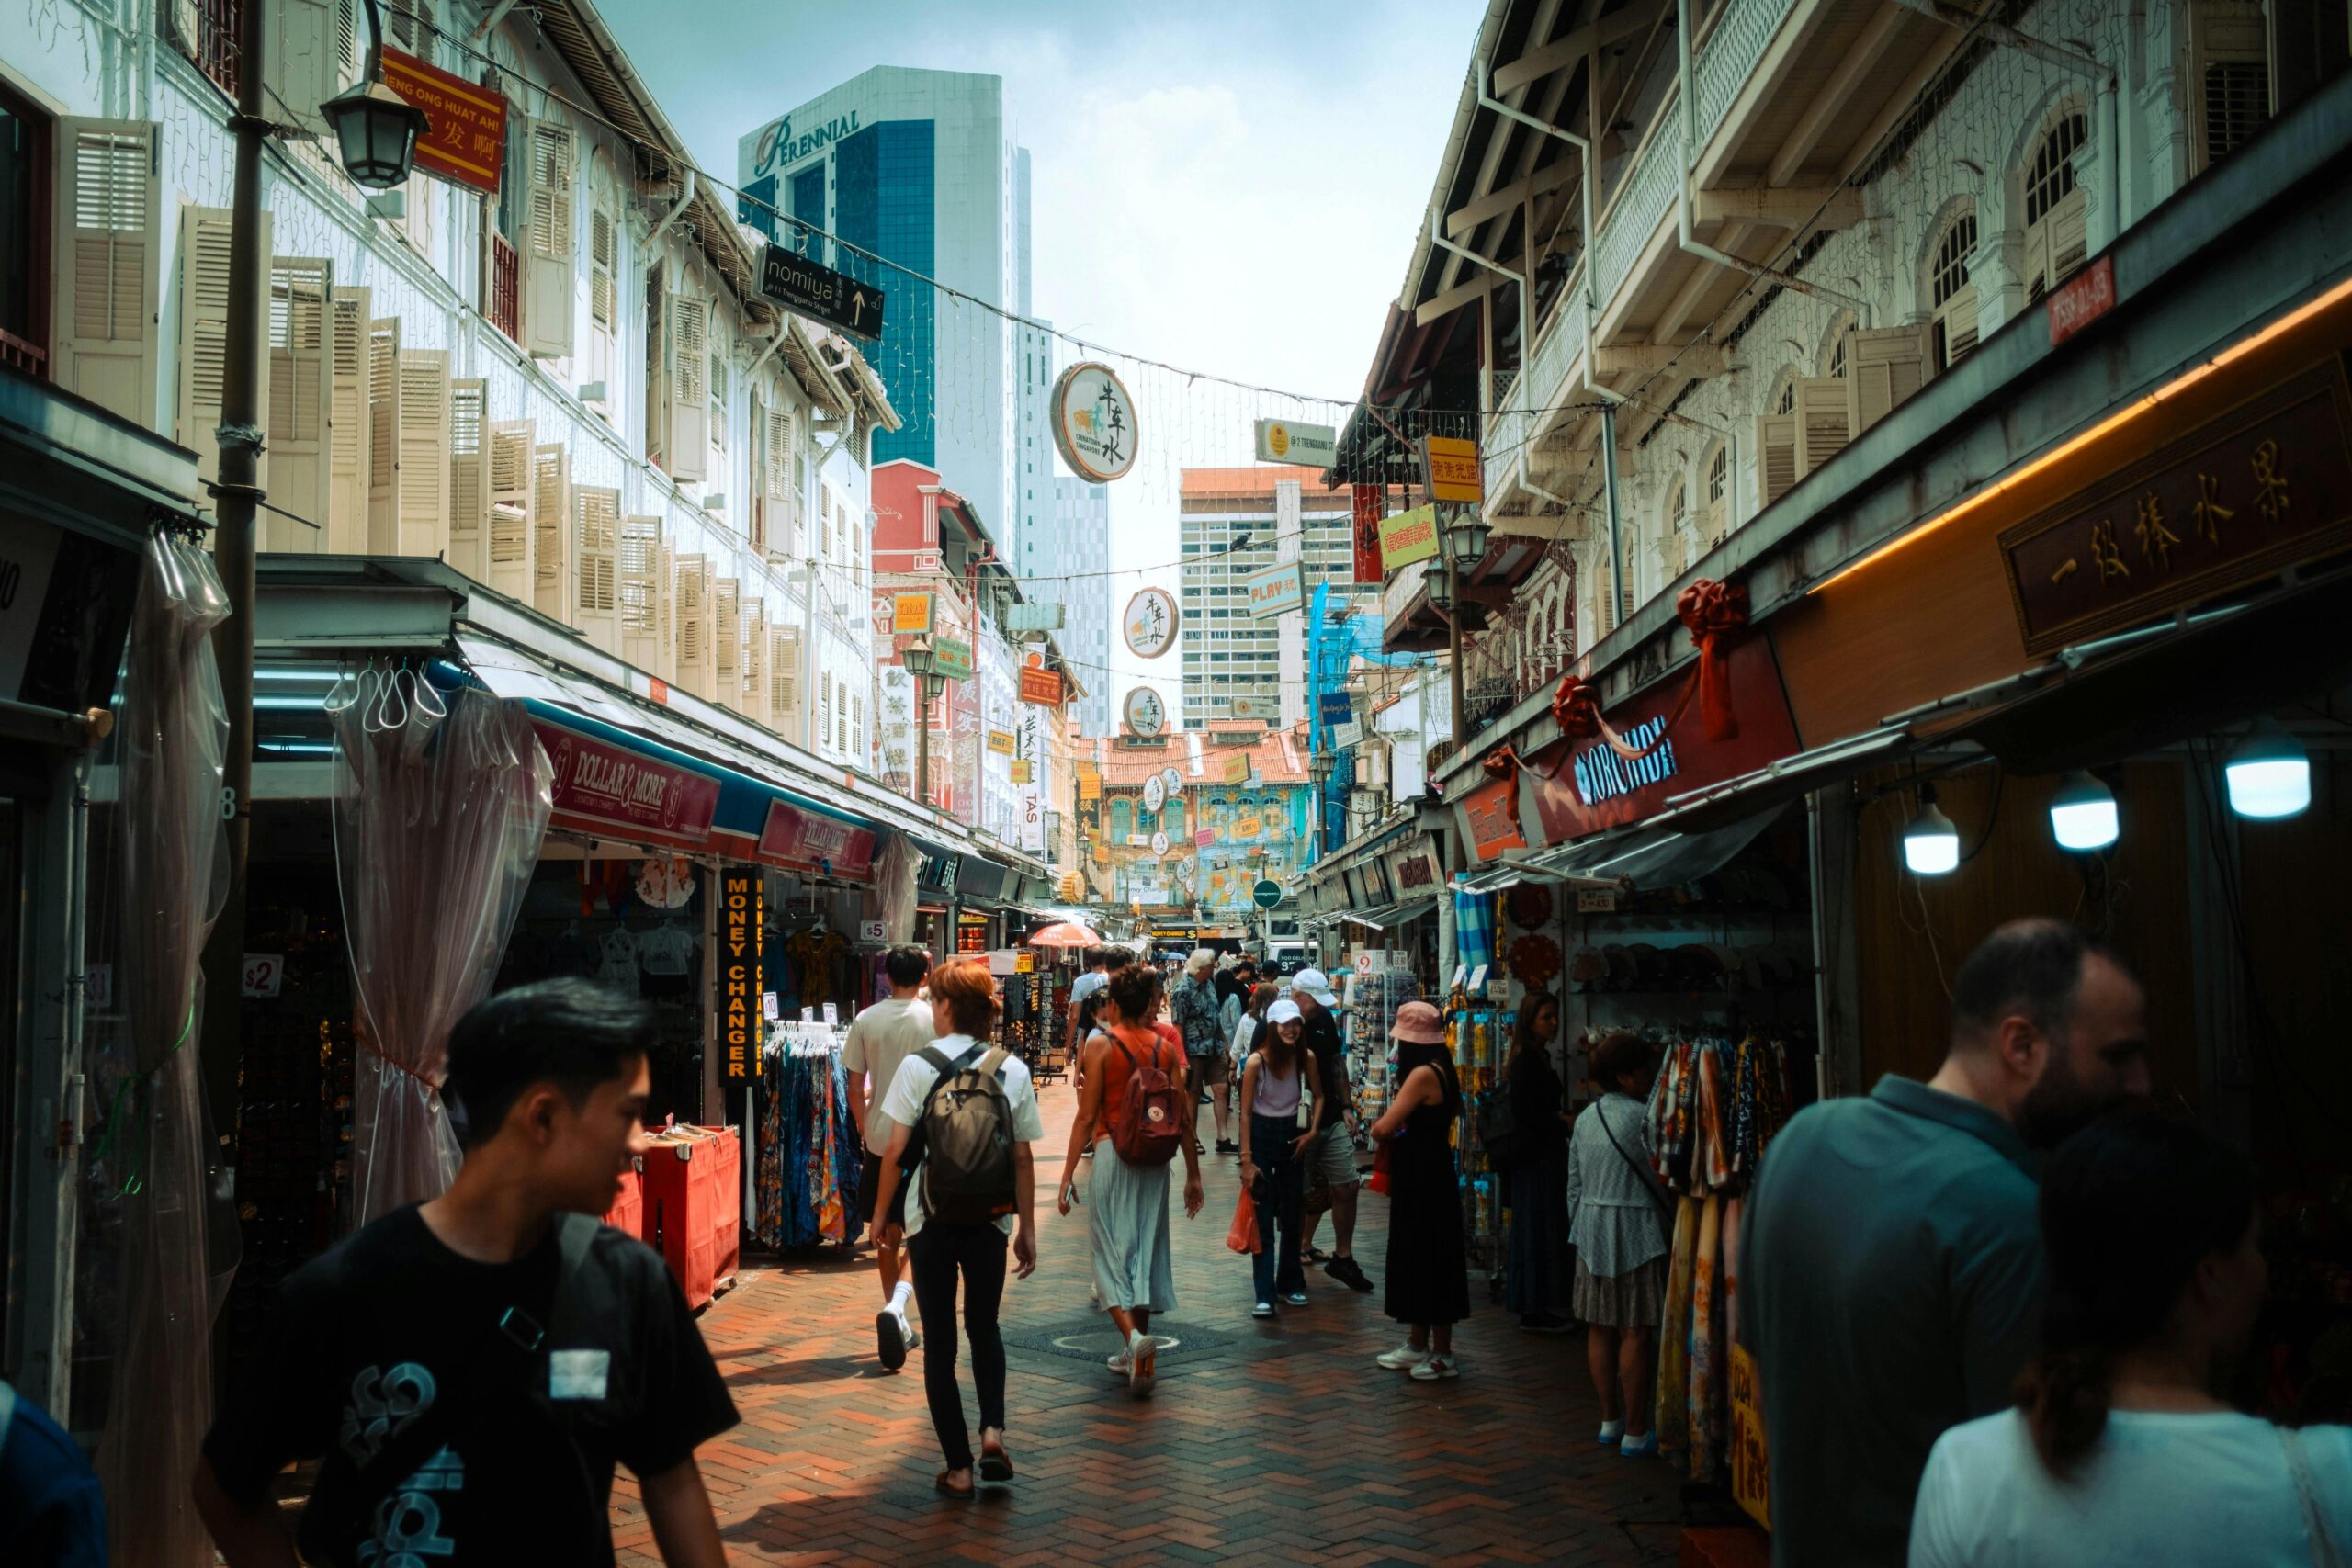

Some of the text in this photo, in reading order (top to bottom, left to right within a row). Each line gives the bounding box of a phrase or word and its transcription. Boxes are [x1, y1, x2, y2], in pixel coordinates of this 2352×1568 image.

[416, 89, 442, 107] ONG
[445, 100, 477, 121] HUAT
[479, 116, 499, 132] AH!
[754, 110, 860, 177] PERENNIAL
[768, 260, 833, 300] nomiya
[782, 287, 814, 307] Trengganu
[813, 300, 831, 314] Street
[1075, 433, 1102, 447] CHINATOWN
[1075, 441, 1101, 456] SINGAPORE
[1250, 580, 1282, 604] PLAY
[572, 750, 626, 797] DOLLAR
[632, 769, 667, 807] MORE
[866, 923, 883, 938] $5
[245, 961, 273, 990] $2
[728, 878, 748, 1077] MONEY CHANGER
[764, 998, 775, 1014] $10
